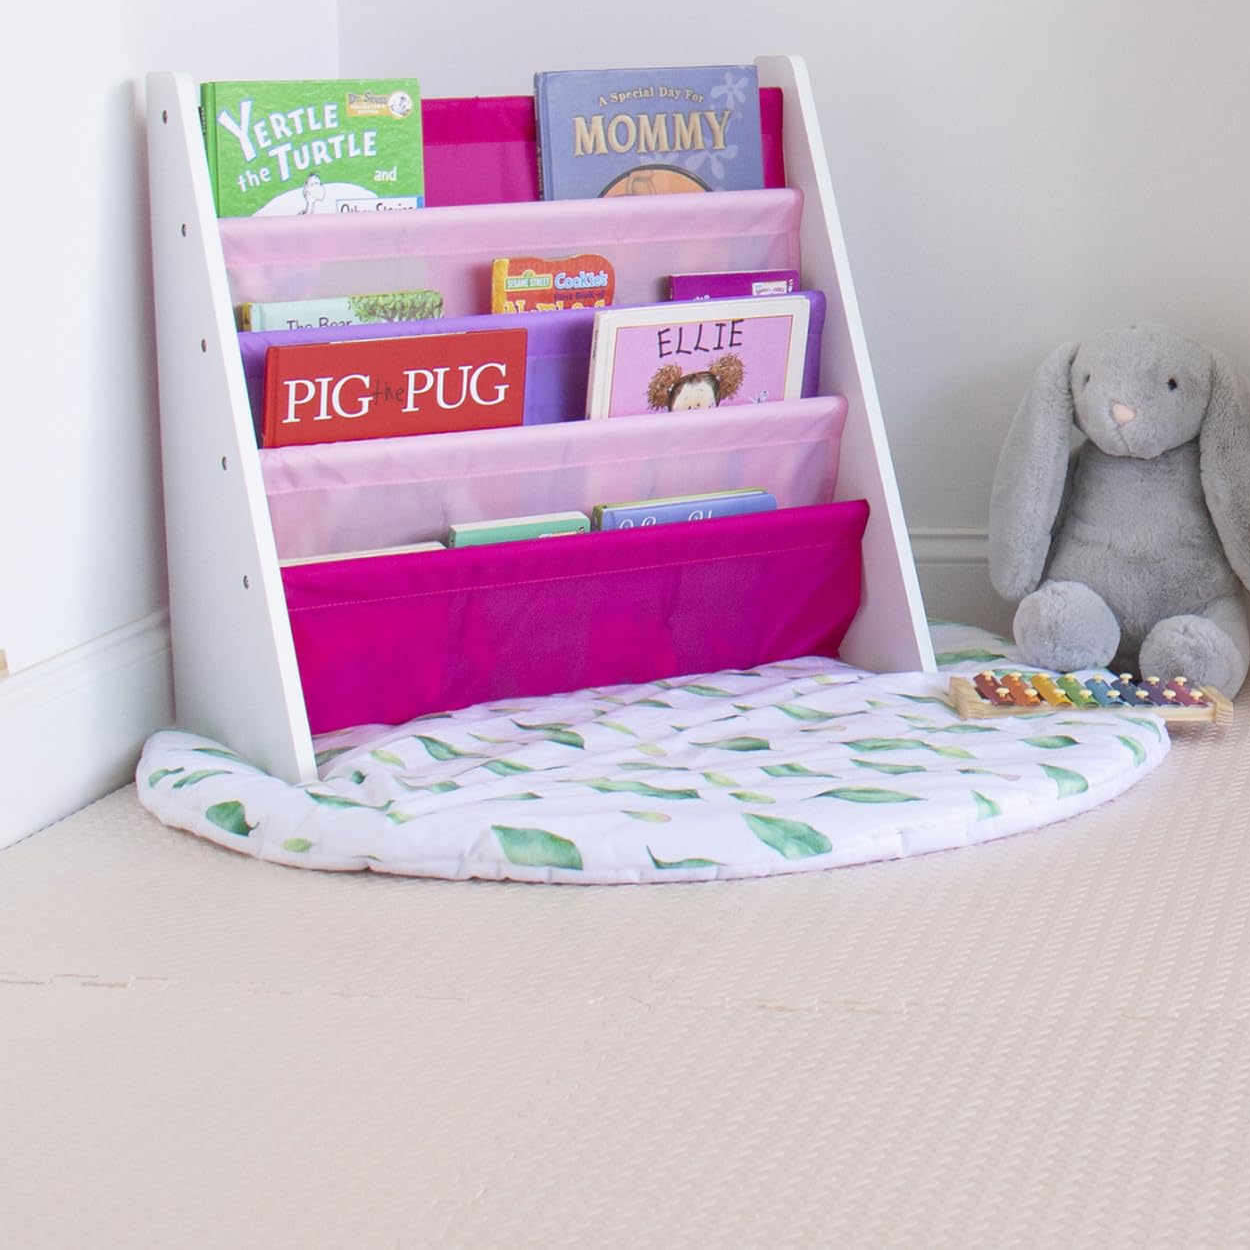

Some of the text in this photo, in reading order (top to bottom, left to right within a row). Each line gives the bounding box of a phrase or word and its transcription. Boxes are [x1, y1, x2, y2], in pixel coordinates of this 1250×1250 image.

[598, 87, 704, 107] A Special Day For
[217, 99, 338, 162] YERTLE
[572, 110, 731, 157] MOMMY
[237, 130, 377, 192] the TURTLE
[374, 167, 397, 181] and
[657, 319, 745, 358] ELLIE
[282, 362, 509, 423] PIG the PUG
